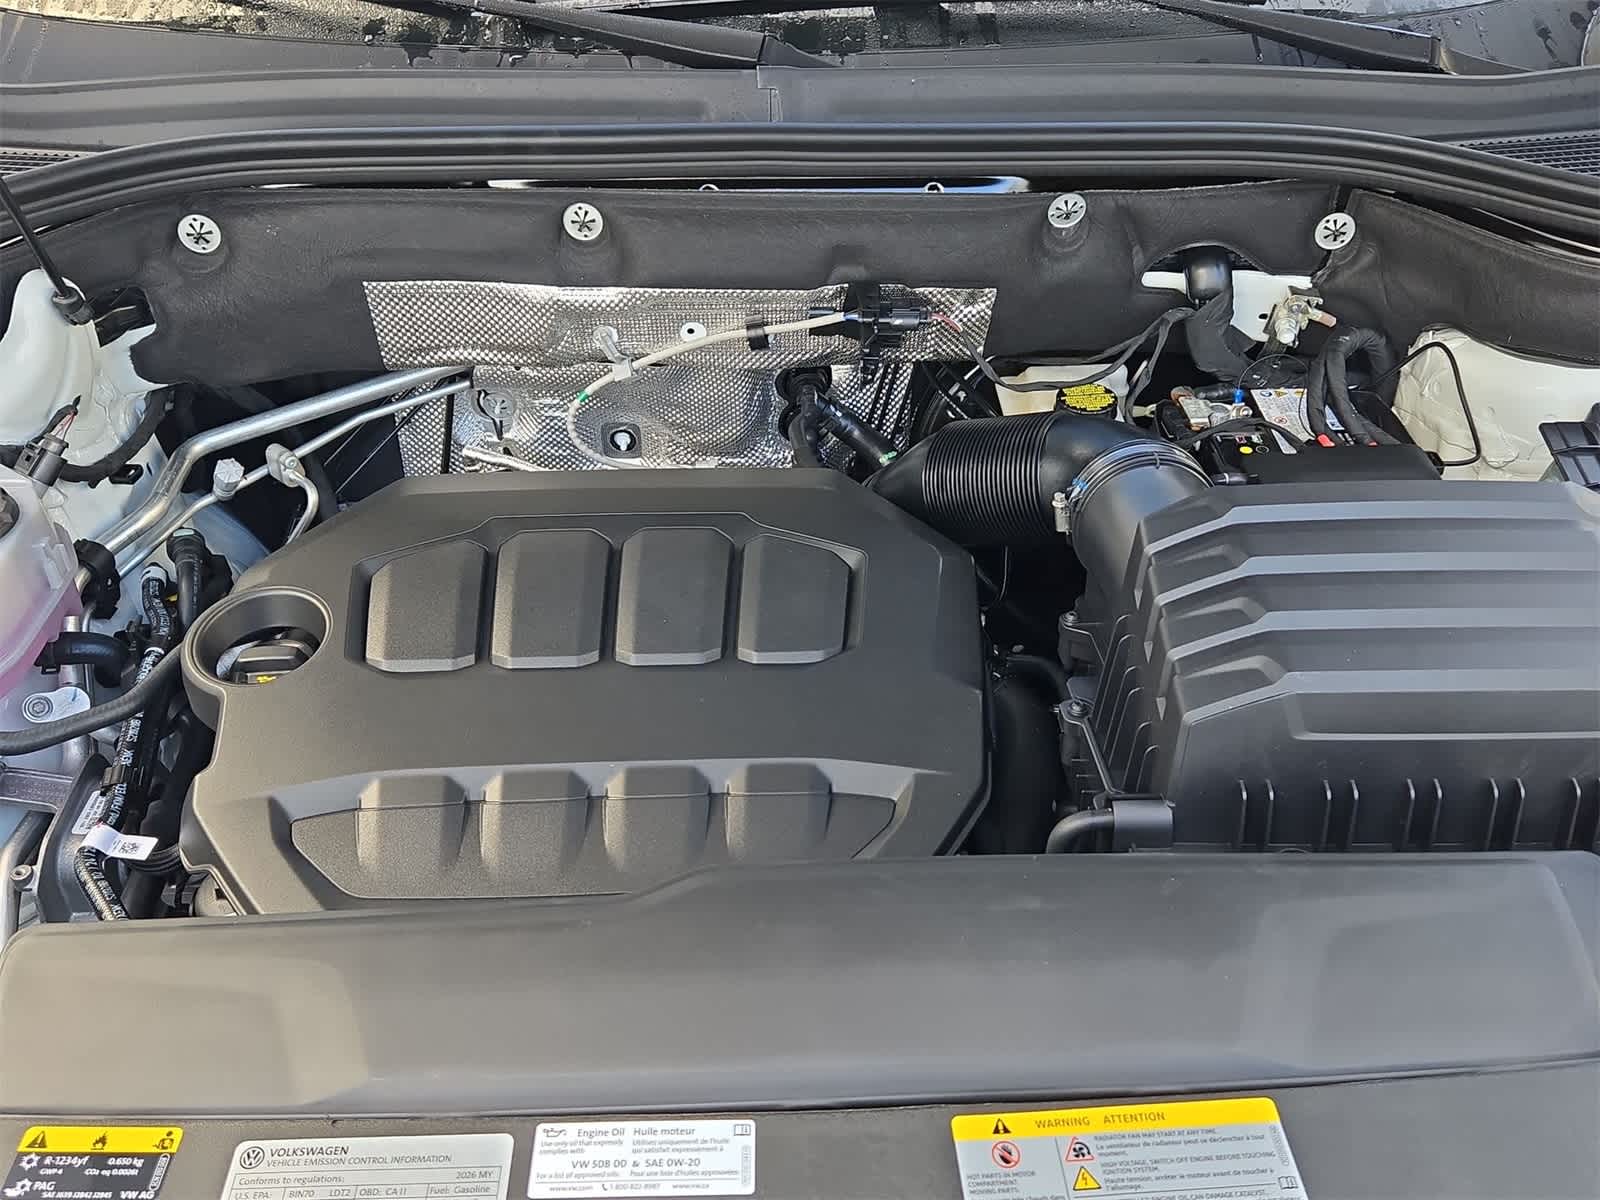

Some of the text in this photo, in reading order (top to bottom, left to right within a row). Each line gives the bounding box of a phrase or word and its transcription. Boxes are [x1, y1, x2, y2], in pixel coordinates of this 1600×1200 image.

[1035, 1111, 1167, 1129] WARNING ATTENTION
[577, 1127, 696, 1139] Engine Oil Huile moteur
[270, 1146, 350, 1158] VOLKSWAGEN
[44, 1155, 145, 1167] R-1234yf 0.650 kg
[266, 1154, 452, 1168] VEHICLE EMISSION CONTROL INFORMATION
[571, 1160, 590, 1169] VW
[592, 1159, 611, 1169] 508
[632, 1160, 641, 1168] &
[645, 1158, 664, 1168] SAE
[666, 1158, 701, 1168] 0W-20
[101, 1169, 111, 1177] eq
[239, 1177, 281, 1186] Conforms
[283, 1177, 291, 1185] to
[456, 1171, 477, 1180] 2026
[479, 1171, 493, 1179] MY
[32, 1180, 56, 1191] PAG
[329, 1189, 351, 1198] LDT2
[454, 1184, 491, 1194] Gasoline
[41, 1191, 57, 1199] SAE
[119, 1190, 138, 1200] VW
[138, 1190, 155, 1200] AG
